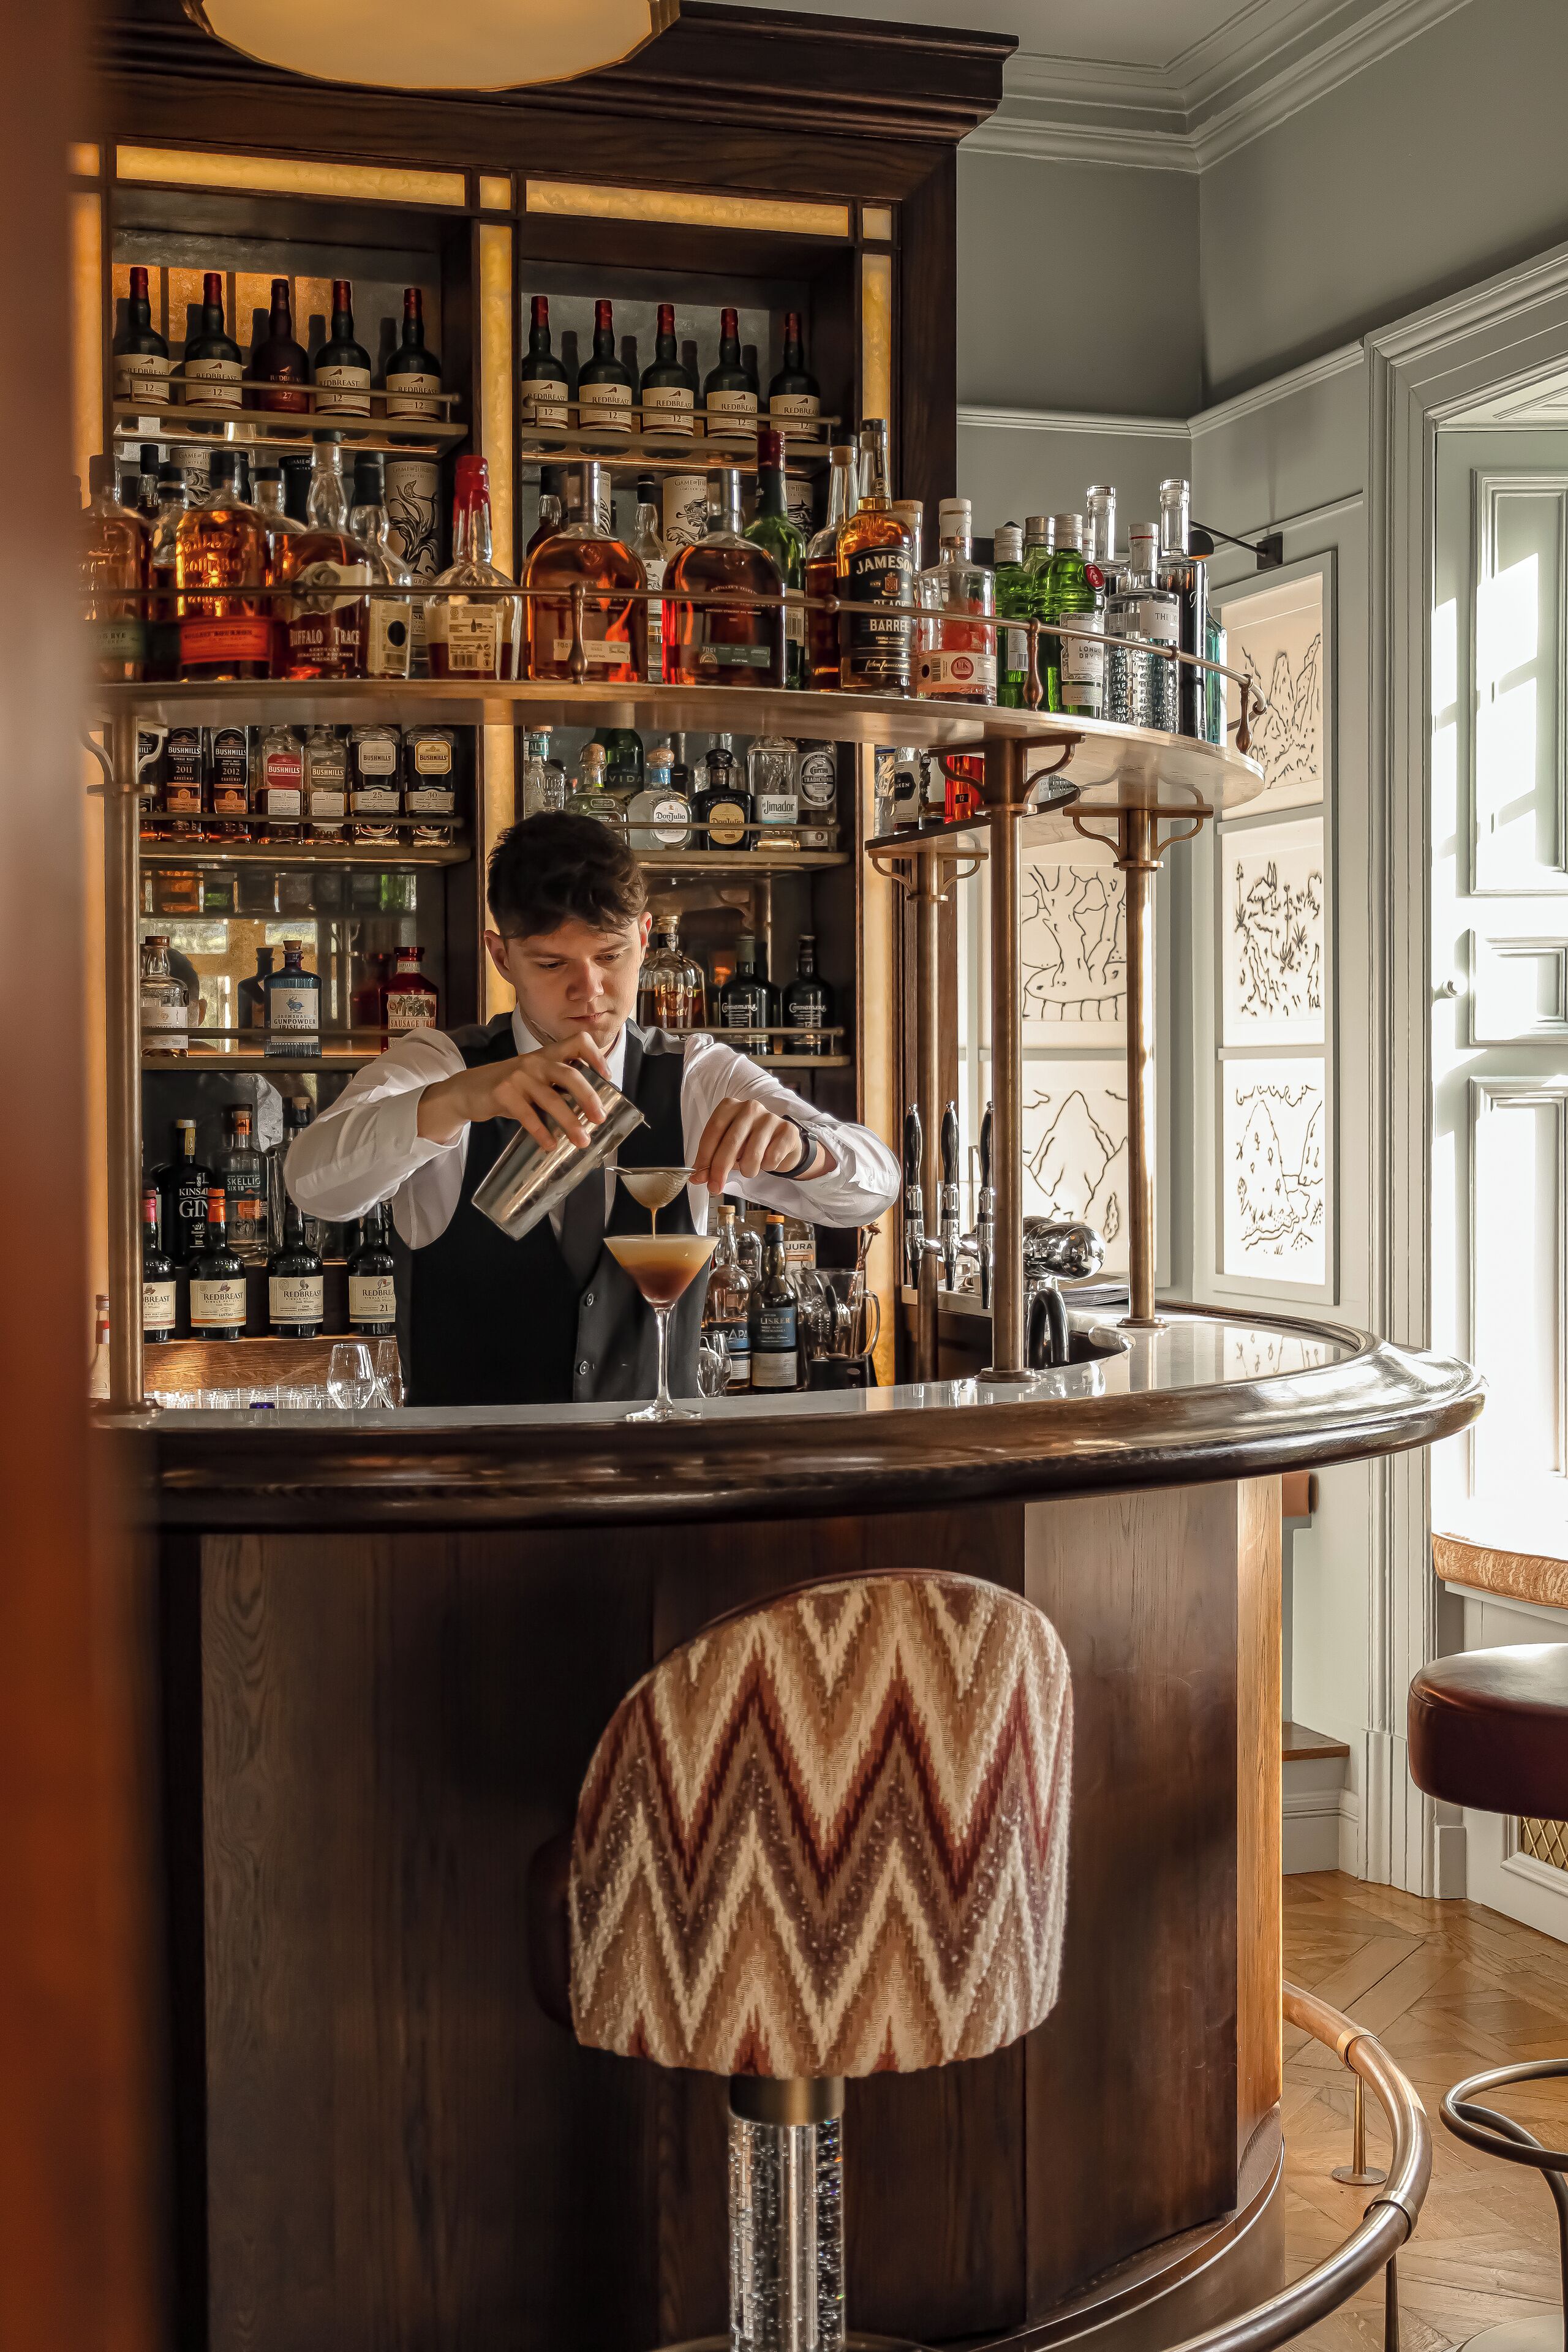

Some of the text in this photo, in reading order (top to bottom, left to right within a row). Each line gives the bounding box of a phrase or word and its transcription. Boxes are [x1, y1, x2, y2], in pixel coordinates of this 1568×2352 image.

[592, 396, 630, 405] REDBREAST
[656, 400, 693, 409] REDBREAST
[856, 555, 913, 575] JAMESON
[870, 619, 910, 633] BARREL
[168, 746, 200, 755] BUSHMILLS
[764, 800, 794, 815] Jimador
[227, 1177, 261, 1186] SKELLIG
[203, 1292, 244, 1300] REDBREAST
